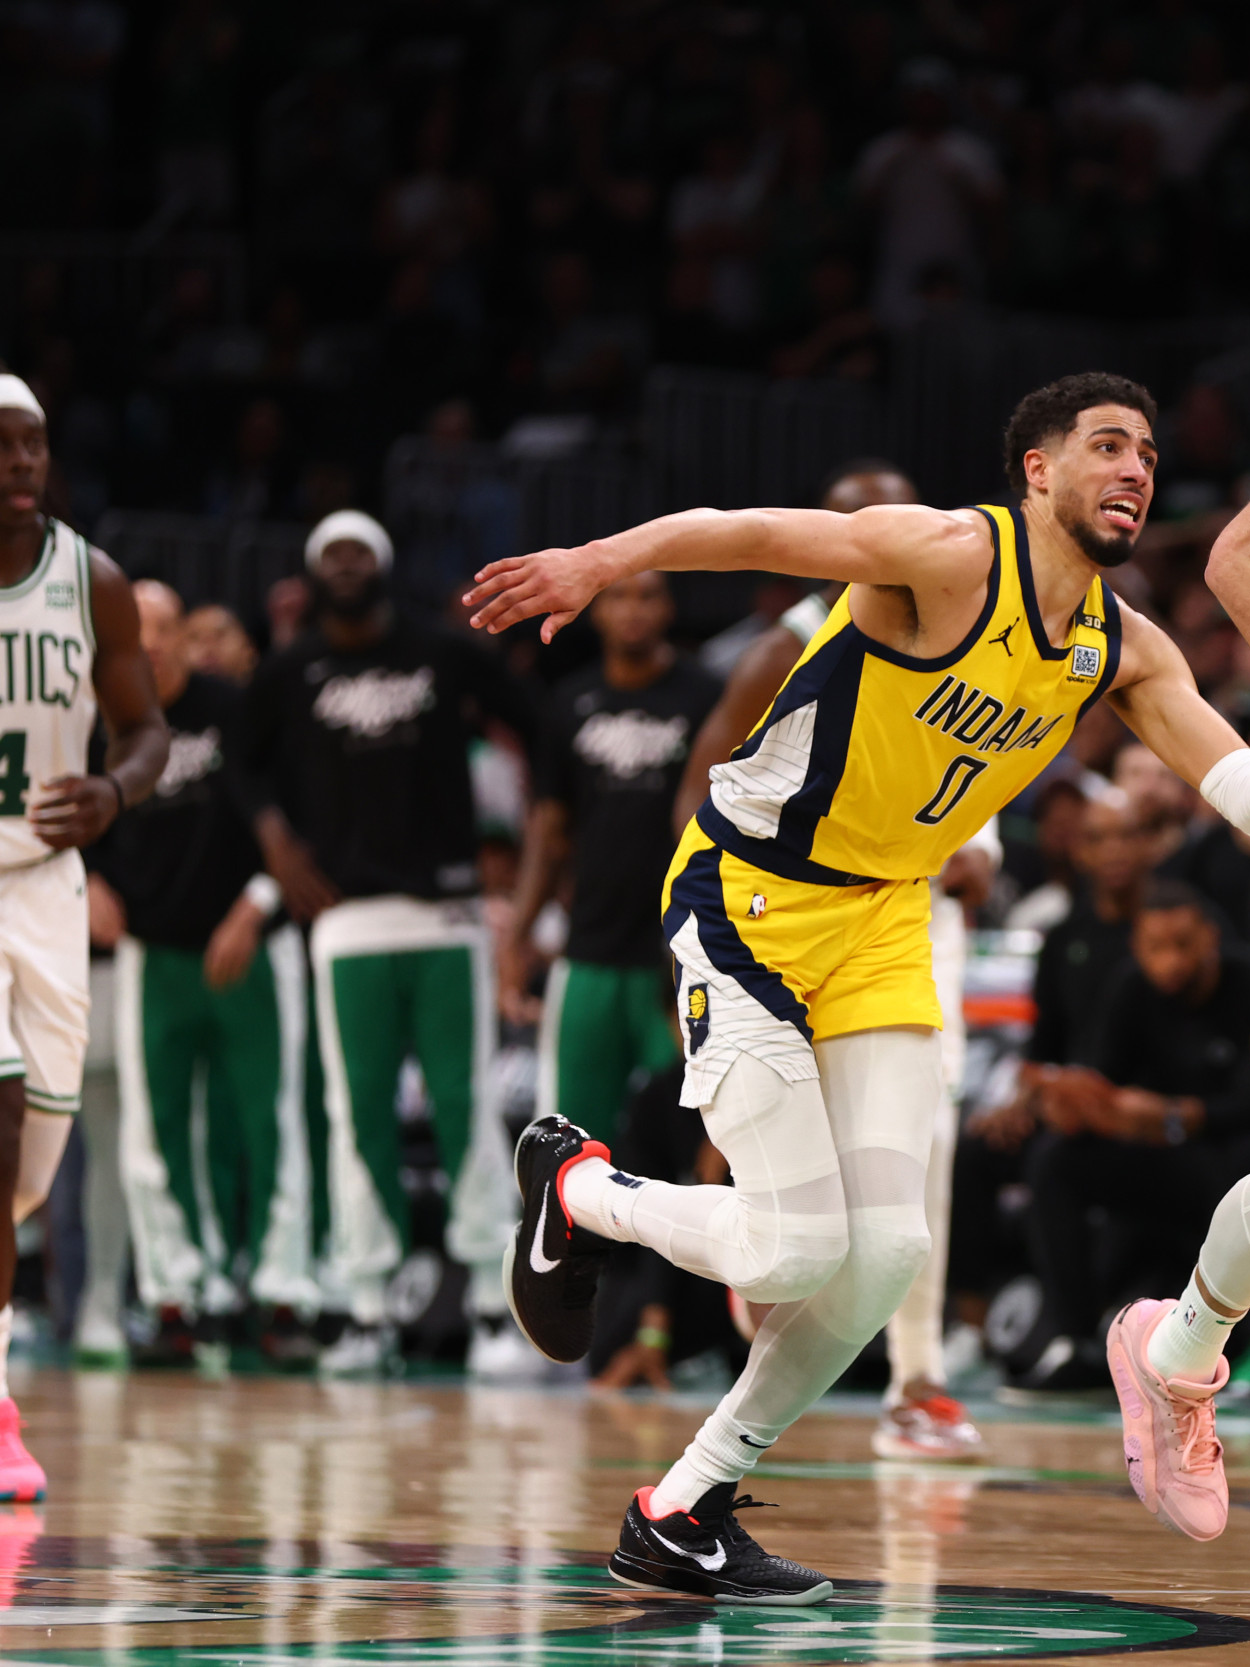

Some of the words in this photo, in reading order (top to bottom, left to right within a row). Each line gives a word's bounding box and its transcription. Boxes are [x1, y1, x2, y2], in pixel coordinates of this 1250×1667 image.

[1084, 616, 1101, 629] 30
[0, 629, 82, 709] TICS
[913, 754, 988, 825] 0
